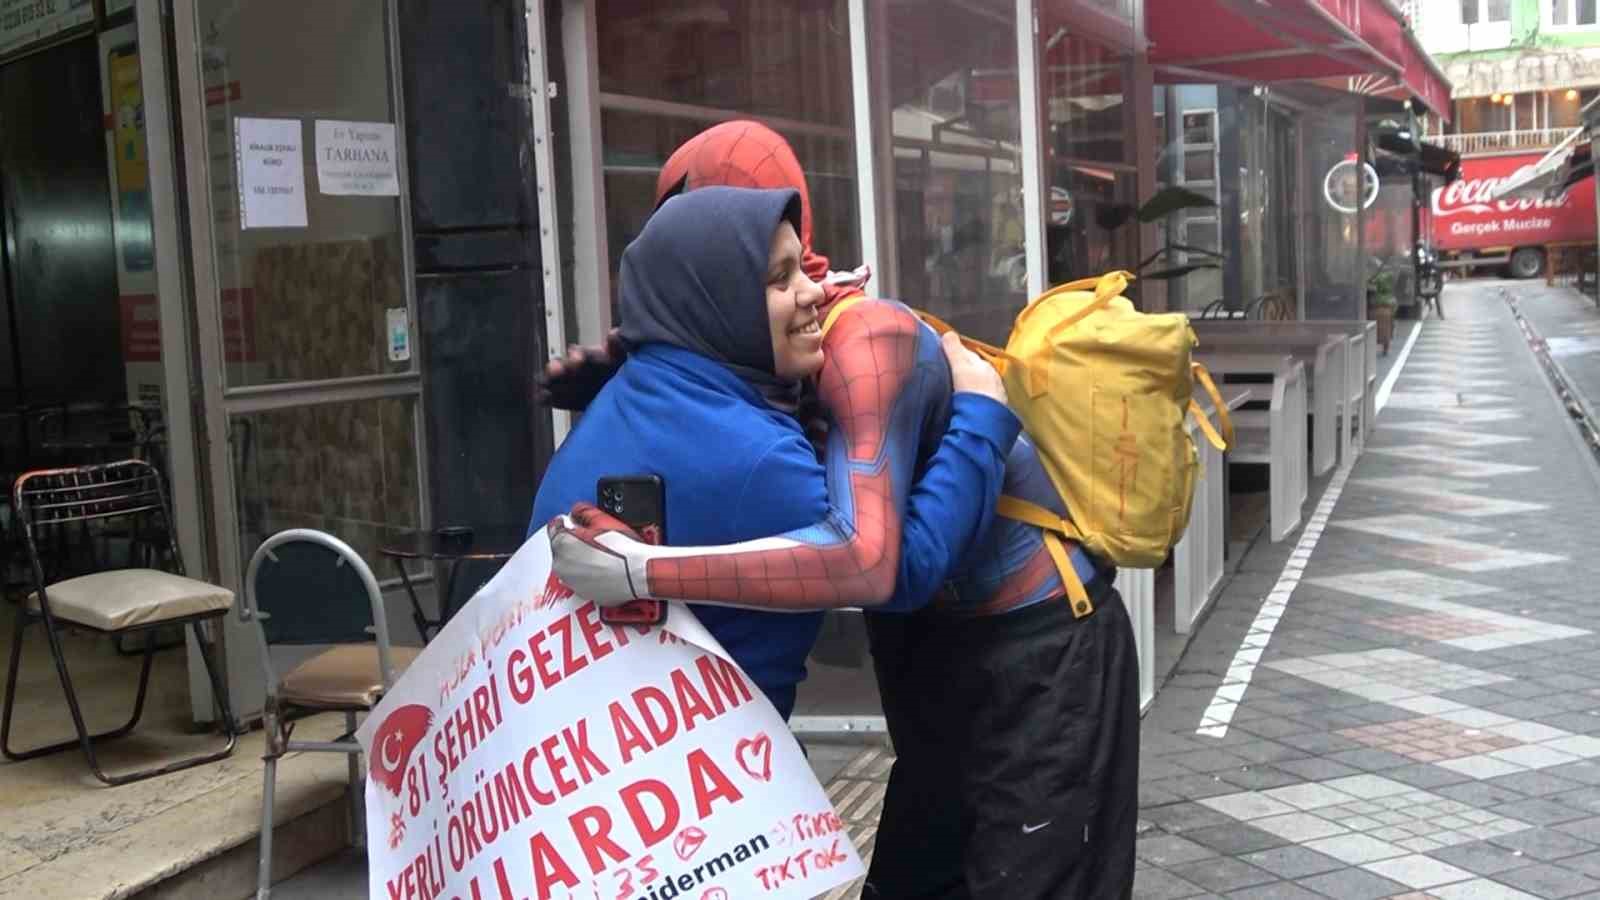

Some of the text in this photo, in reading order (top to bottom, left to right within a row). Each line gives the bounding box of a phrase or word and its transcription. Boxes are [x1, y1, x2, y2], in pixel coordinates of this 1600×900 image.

[324, 147, 390, 163] TARHANA
[1451, 216, 1551, 235] Gerçek Mucize
[407, 753, 431, 817] 81
[434, 659, 503, 799] ŞEHRİ
[447, 717, 610, 873] ÖRÜMCEK
[608, 654, 753, 763] ADAM
[637, 833, 770, 900] iderman
